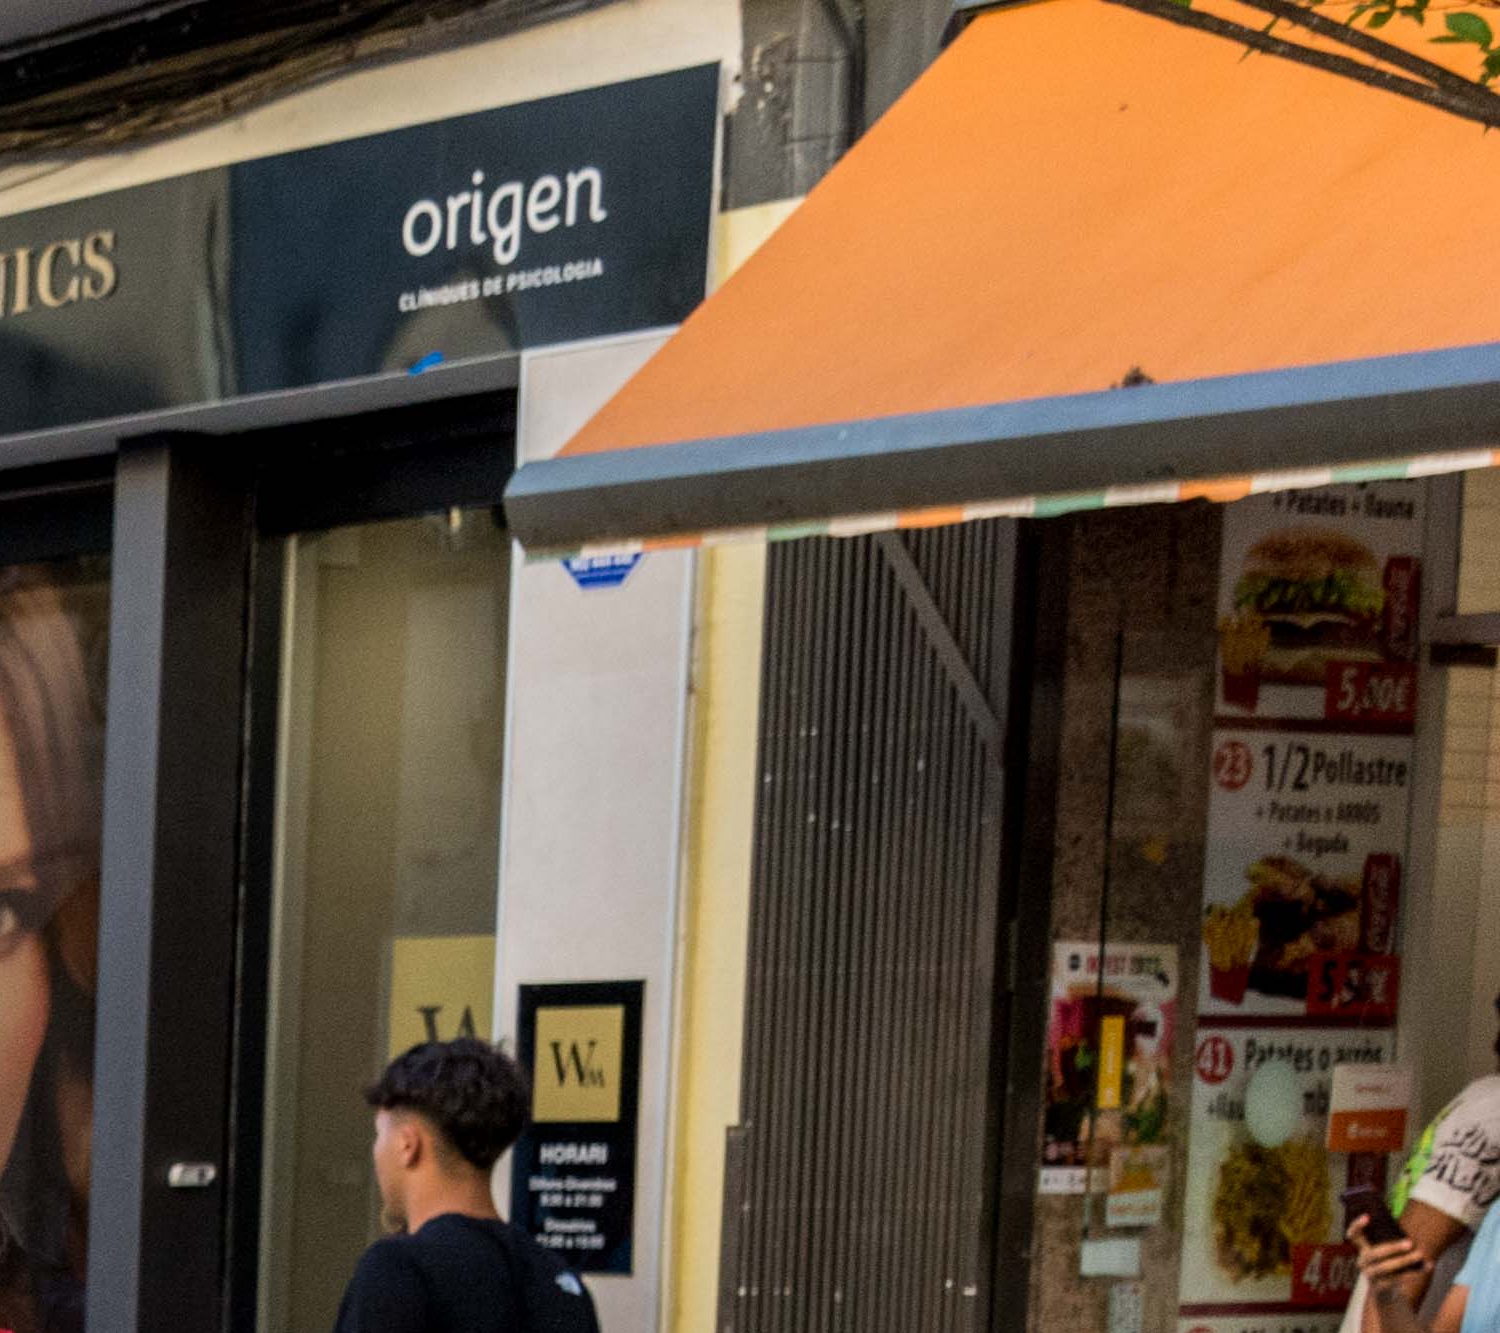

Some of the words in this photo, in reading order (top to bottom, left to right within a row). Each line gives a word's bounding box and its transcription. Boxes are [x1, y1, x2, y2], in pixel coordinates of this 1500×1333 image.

[403, 167, 607, 266] origen
[483, 276, 503, 297] DE
[1263, 741, 1310, 792] 1/2
[1312, 747, 1408, 788] Pollastre
[540, 1142, 608, 1165] HORARI
